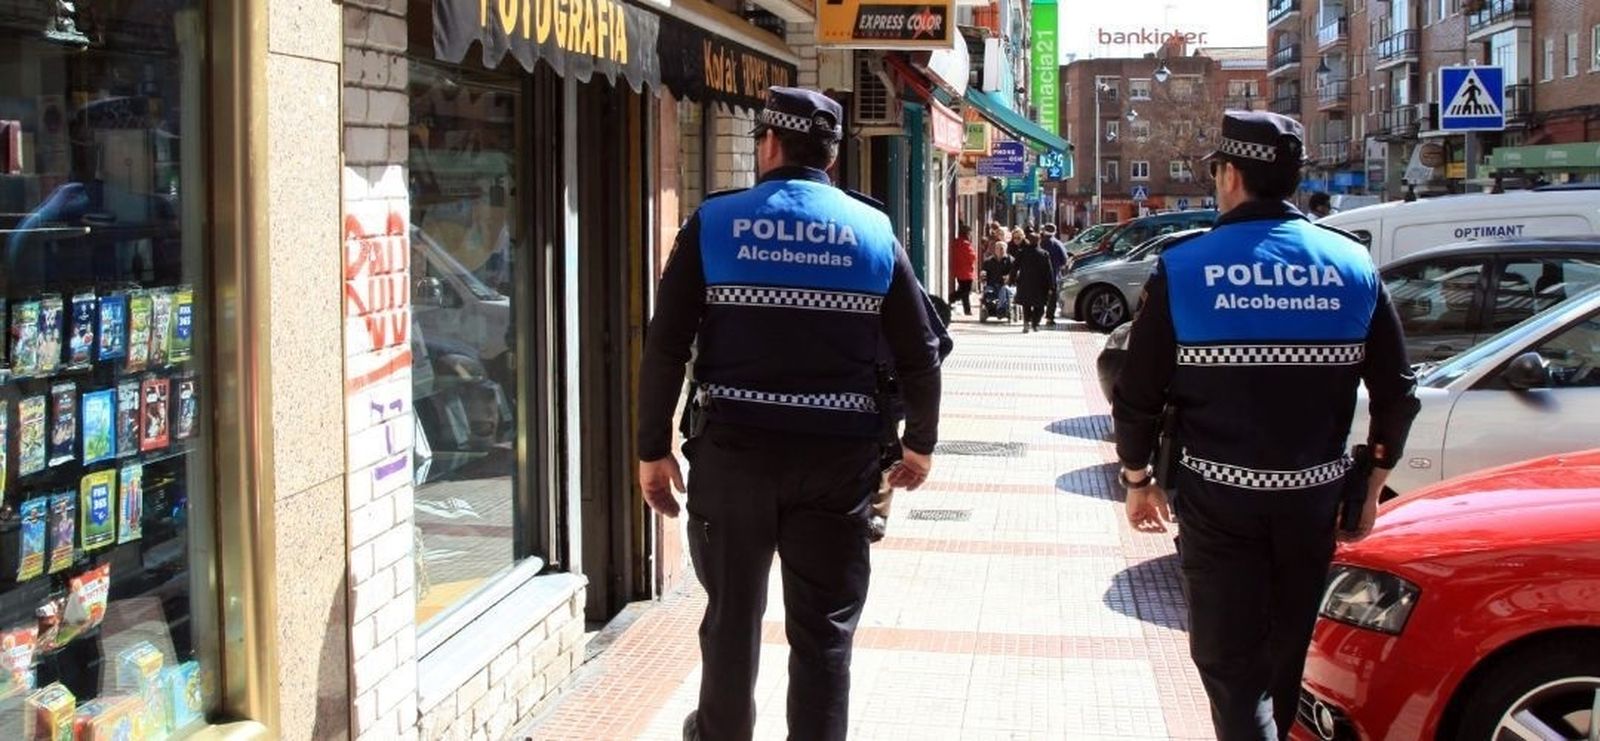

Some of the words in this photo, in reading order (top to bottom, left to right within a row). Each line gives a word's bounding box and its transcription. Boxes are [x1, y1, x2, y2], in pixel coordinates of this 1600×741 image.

[859, 14, 904, 30] EXPRESS
[907, 14, 942, 31] COLOR
[1454, 225, 1525, 239] OPTIMANT
[736, 244, 852, 266] Alcobendas
[1204, 263, 1345, 287] POLICIA
[1214, 293, 1341, 310] Alcobendas
